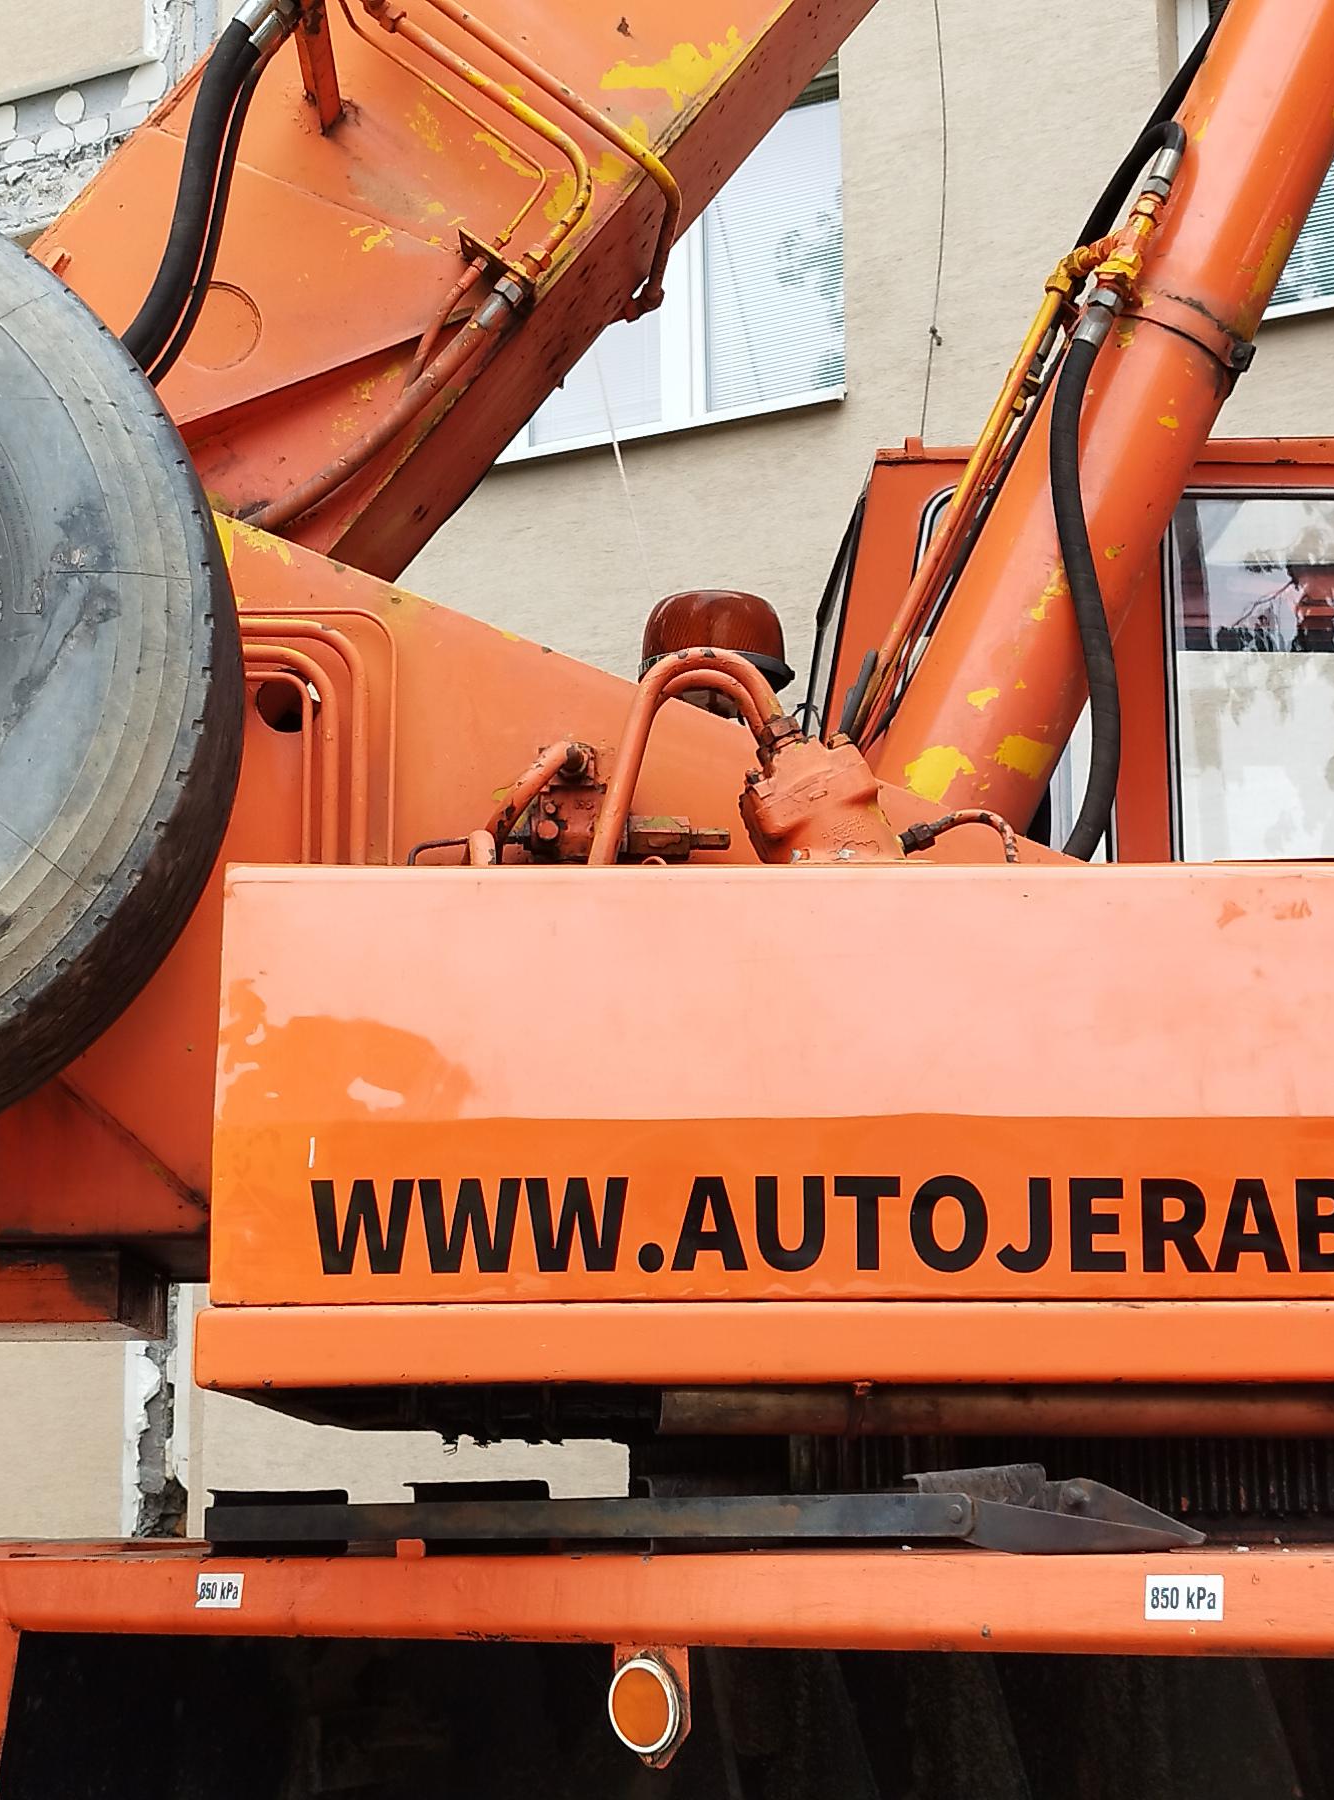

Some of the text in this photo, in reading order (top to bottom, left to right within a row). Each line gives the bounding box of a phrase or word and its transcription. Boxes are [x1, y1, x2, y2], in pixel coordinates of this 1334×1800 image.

[198, 1581, 239, 1601] 850 kPa
[1150, 1586, 1216, 1610] 850 kPa
